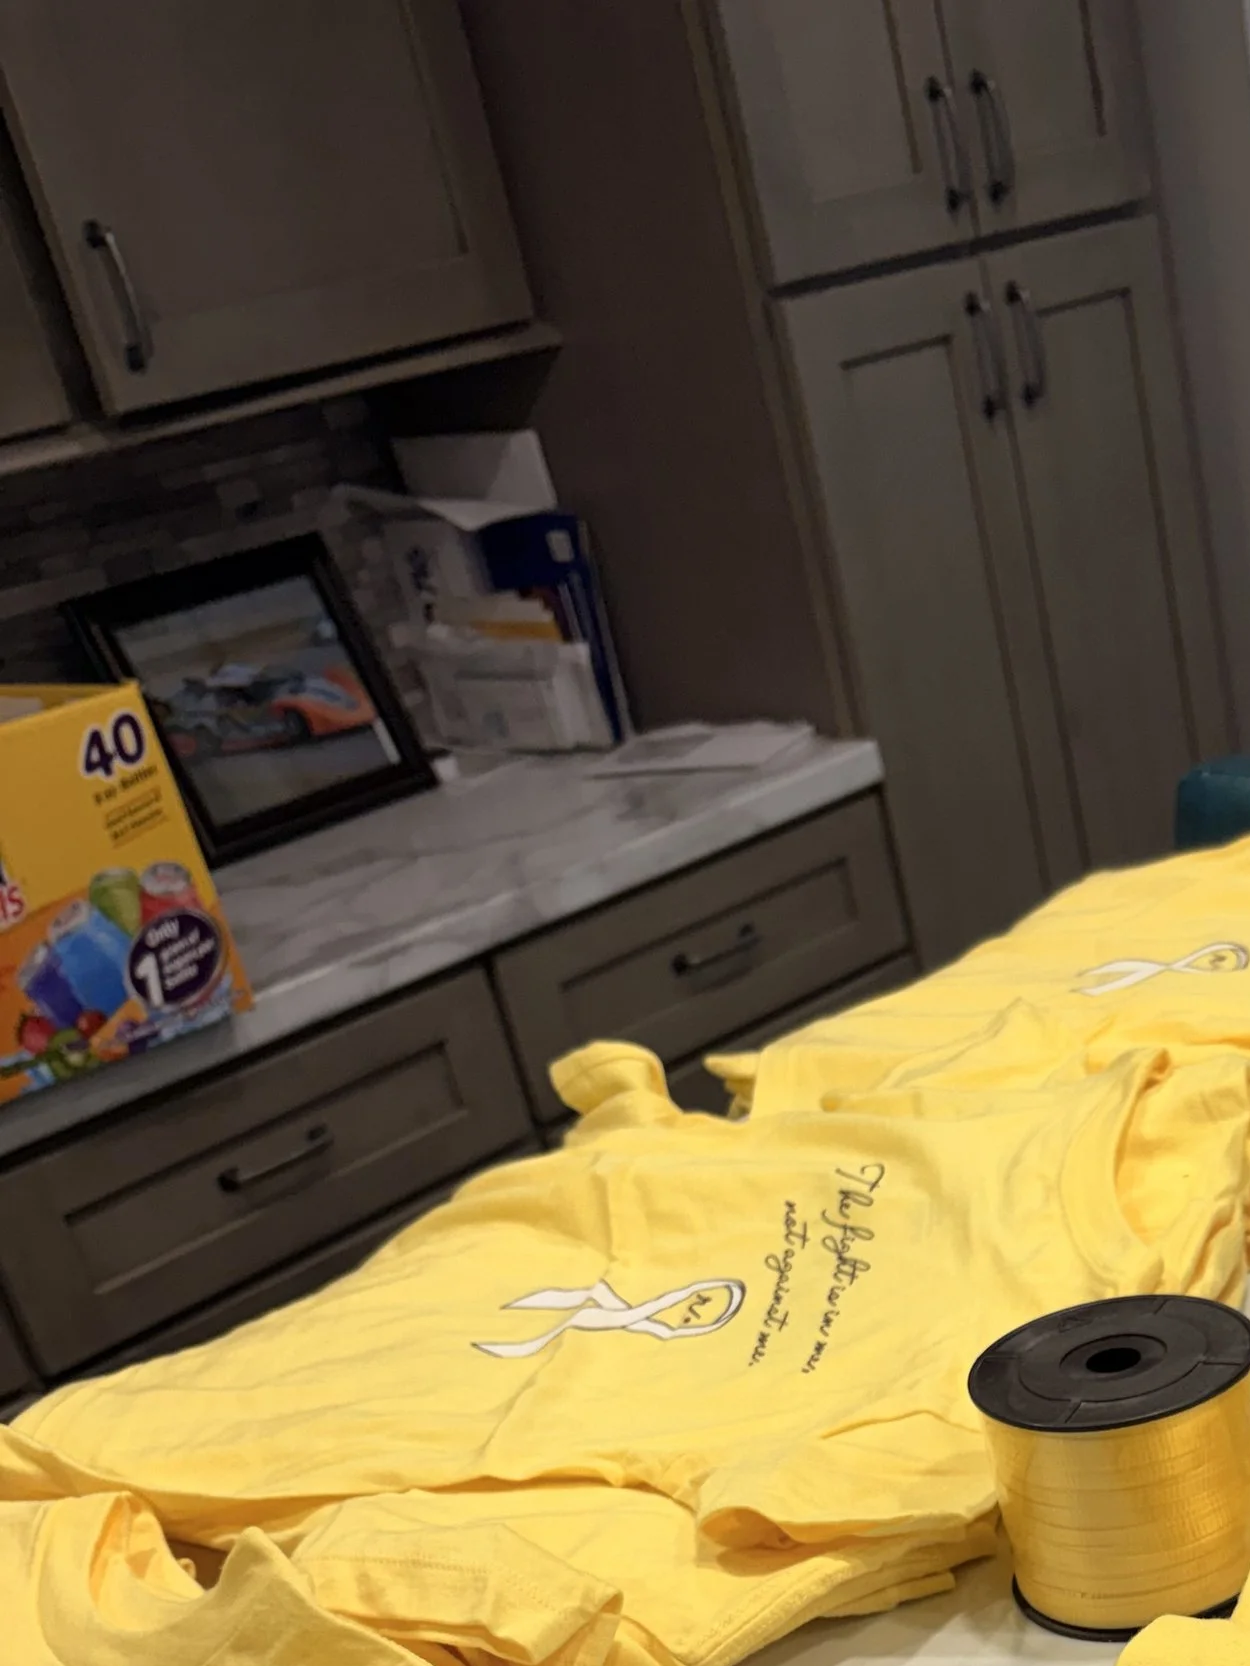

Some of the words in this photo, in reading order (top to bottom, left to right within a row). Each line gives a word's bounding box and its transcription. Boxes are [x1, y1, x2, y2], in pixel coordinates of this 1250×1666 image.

[84, 712, 145, 777] 40
[134, 951, 165, 1009] 1
[834, 1163, 885, 1219] The
[784, 1200, 810, 1250] not
[821, 1208, 875, 1286] fight
[764, 1247, 796, 1332] against
[827, 1285, 847, 1307] is
[819, 1310, 840, 1337] in
